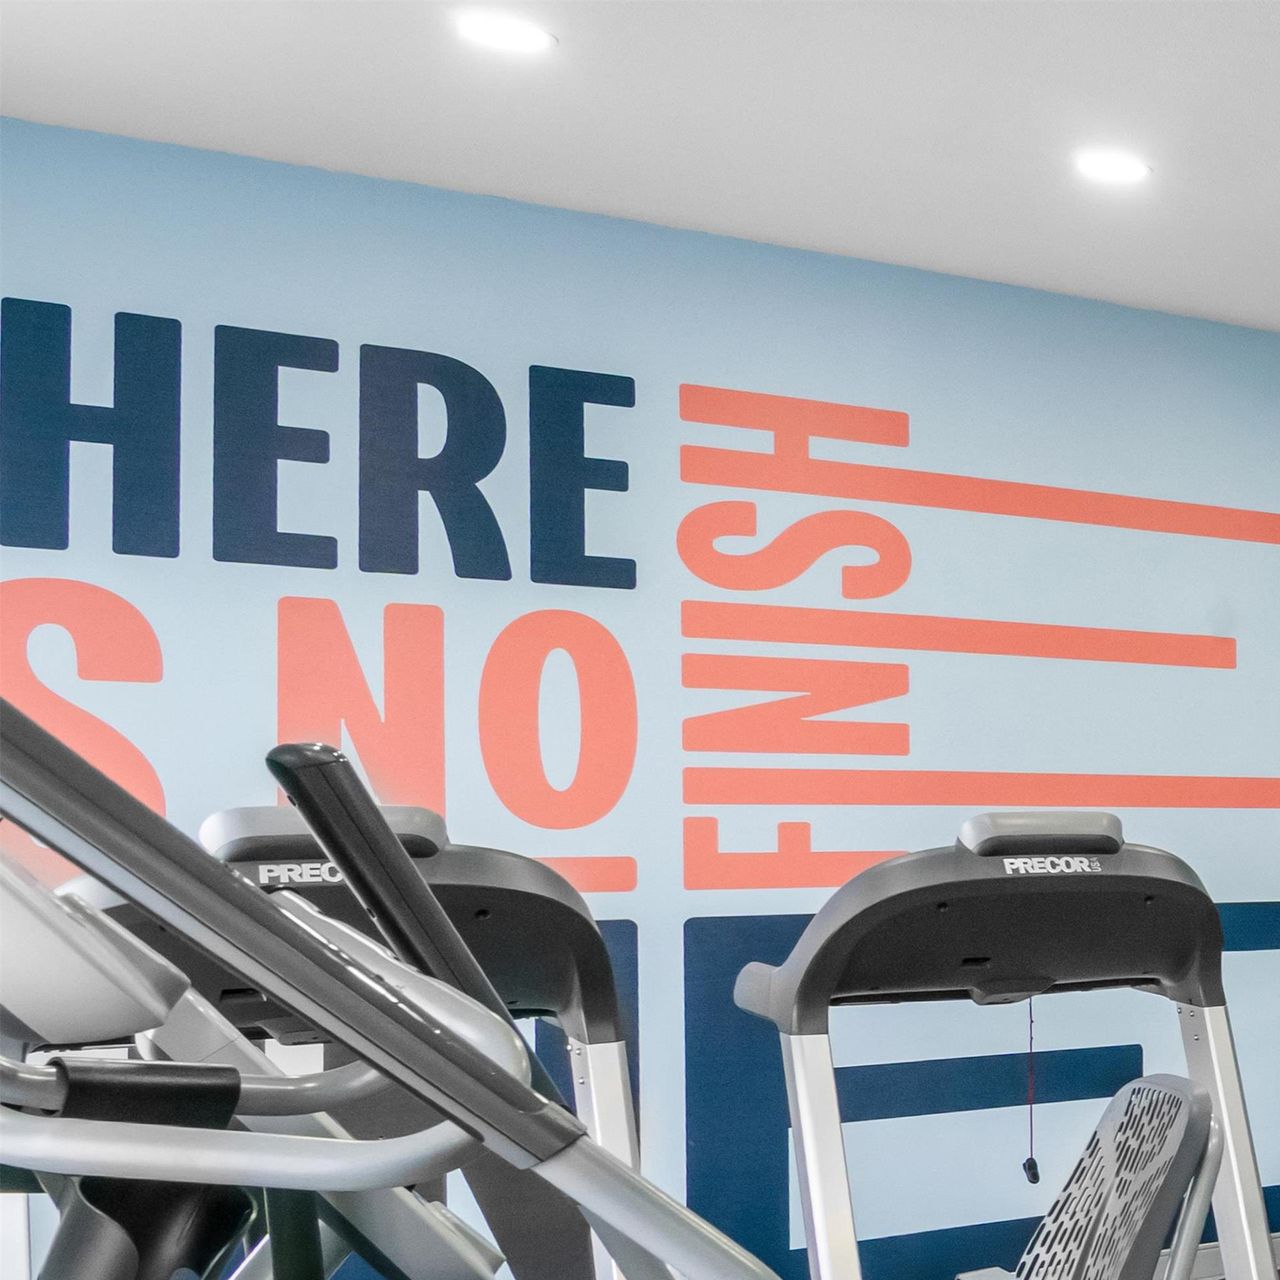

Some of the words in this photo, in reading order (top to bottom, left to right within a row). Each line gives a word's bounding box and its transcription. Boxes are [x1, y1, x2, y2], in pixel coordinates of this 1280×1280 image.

[0, 297, 637, 590] HERE
[277, 595, 639, 830] NO
[676, 383, 912, 891] FINISH
[258, 862, 344, 884] PREC
[1002, 856, 1092, 875] PRECOR
